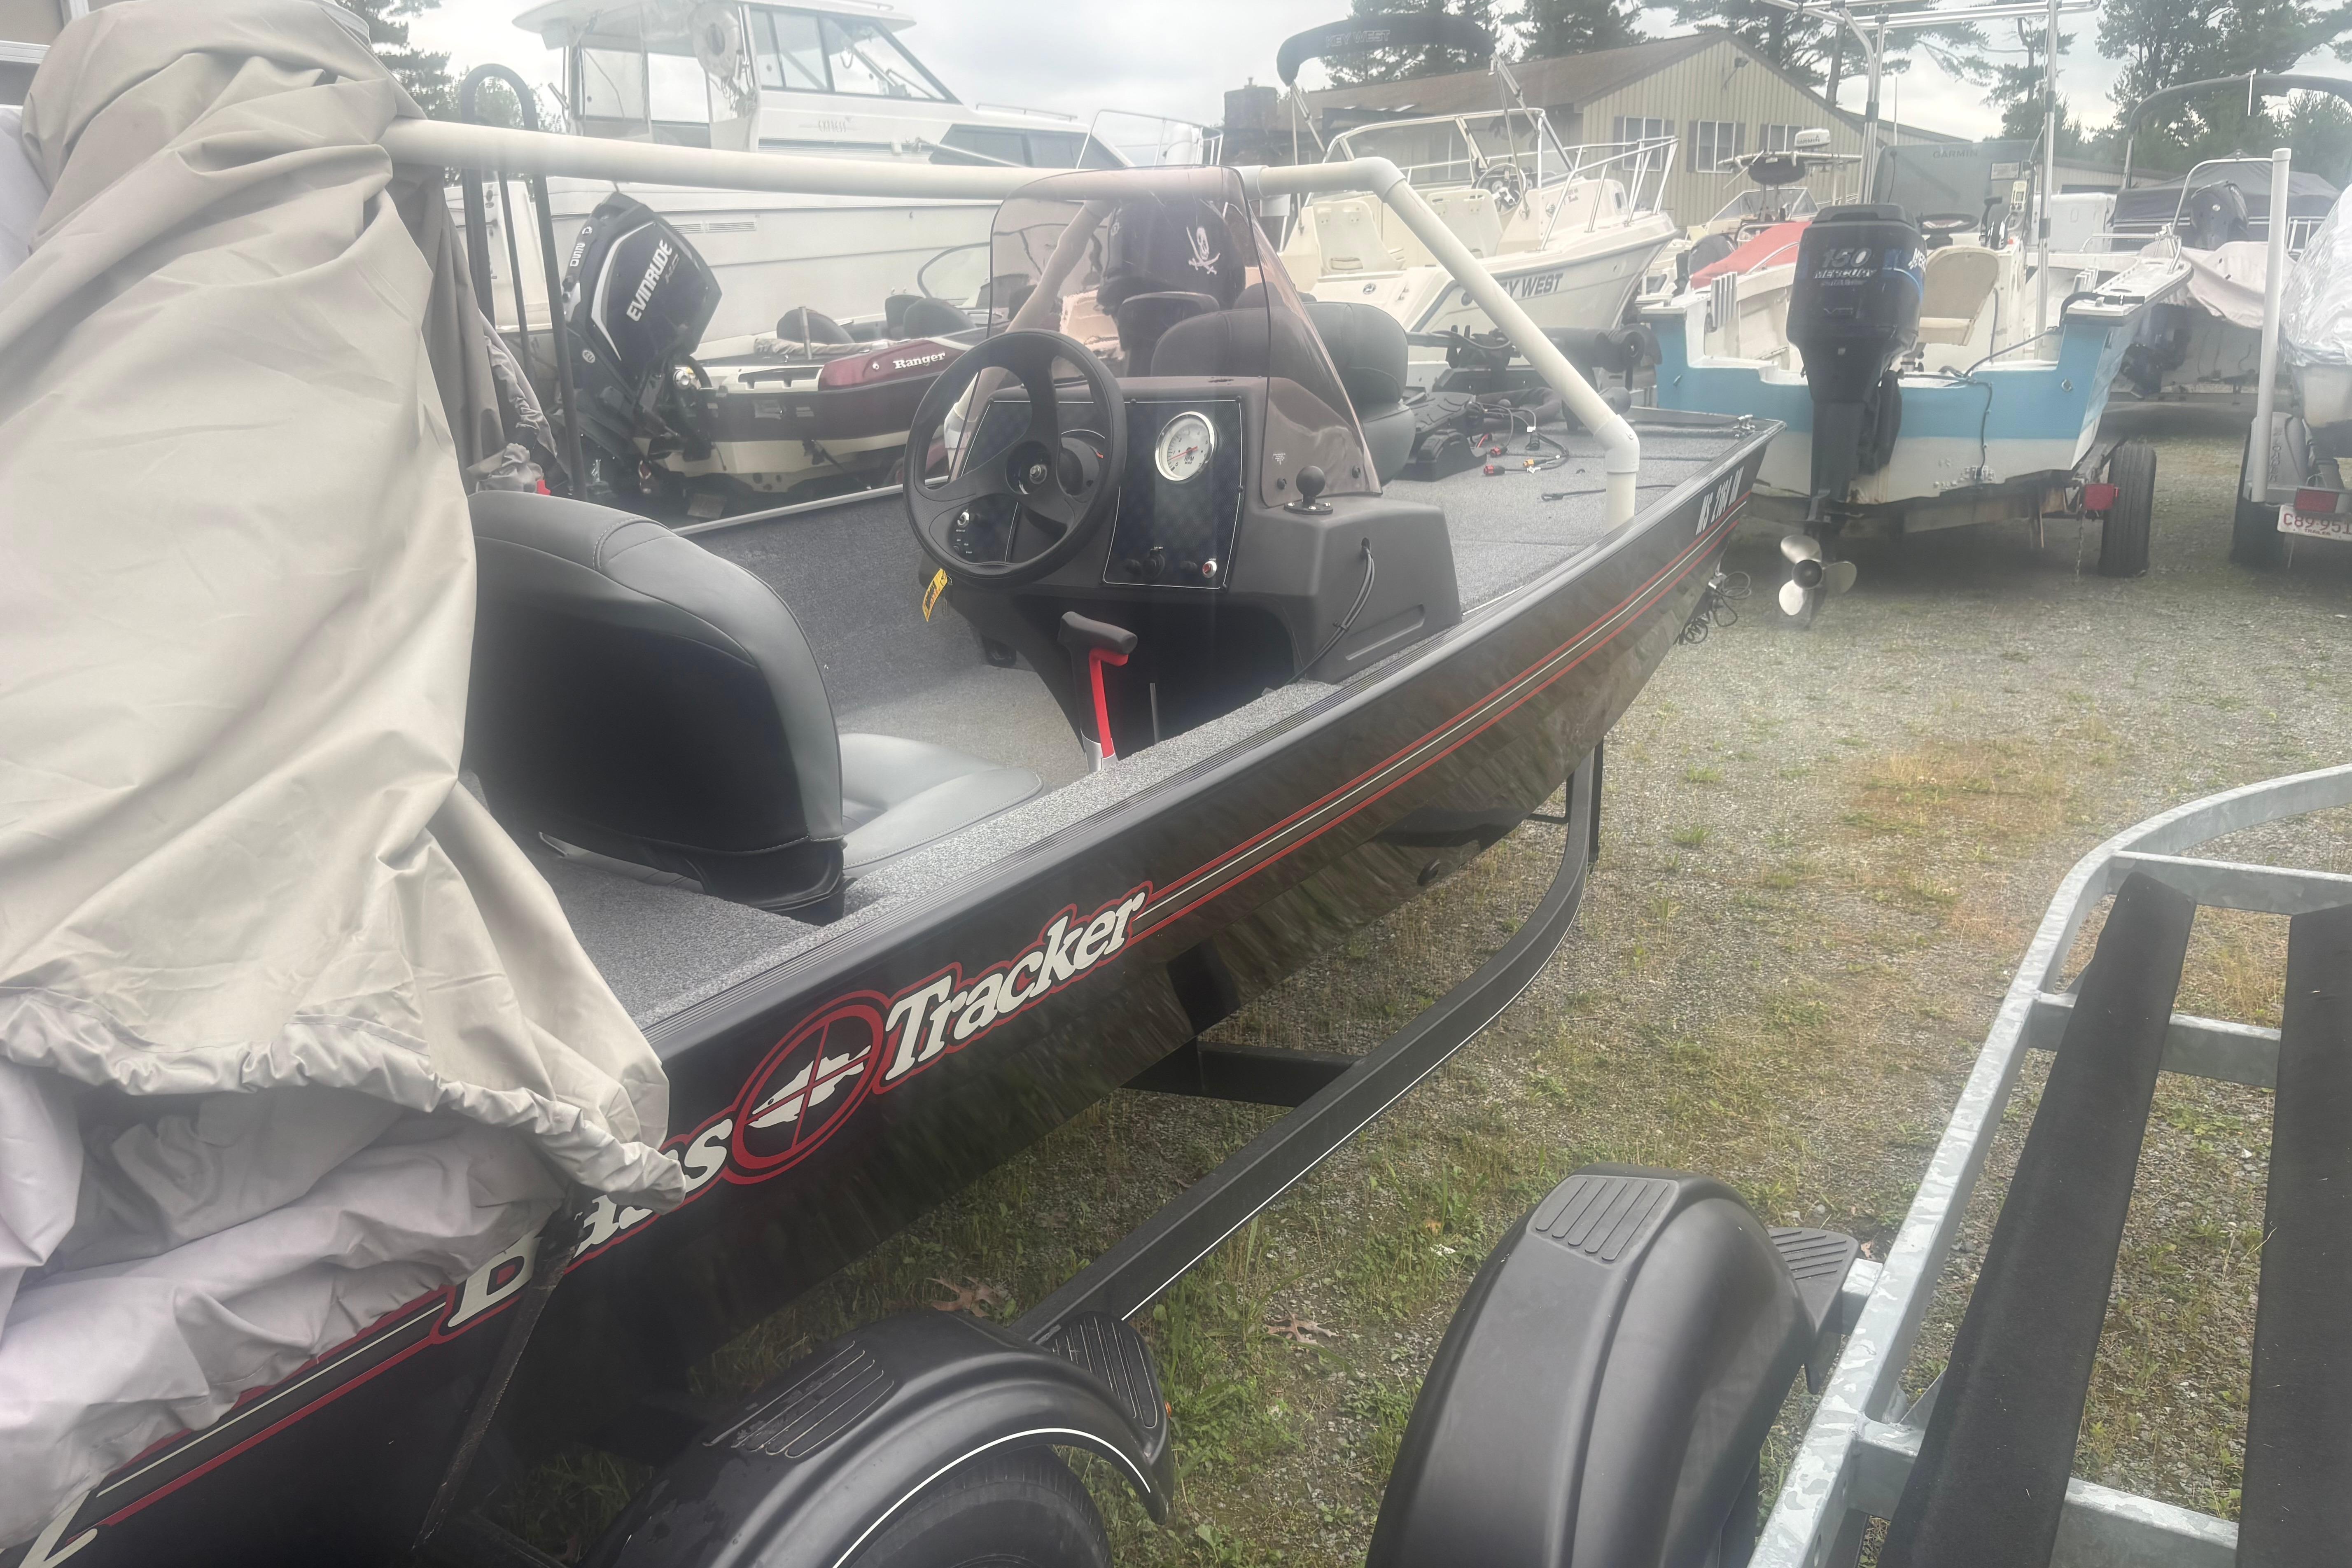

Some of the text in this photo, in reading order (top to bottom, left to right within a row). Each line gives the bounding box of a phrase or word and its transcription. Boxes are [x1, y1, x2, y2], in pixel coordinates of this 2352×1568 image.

[1325, 30, 1390, 48] KEY WEST
[1932, 149, 1978, 159] GARMIN
[1822, 248, 1871, 268] 150
[626, 239, 672, 321] EVINRUDE
[1521, 273, 1563, 297] WEST
[893, 352, 945, 369] Ranger
[885, 891, 1146, 1081] Tracker
